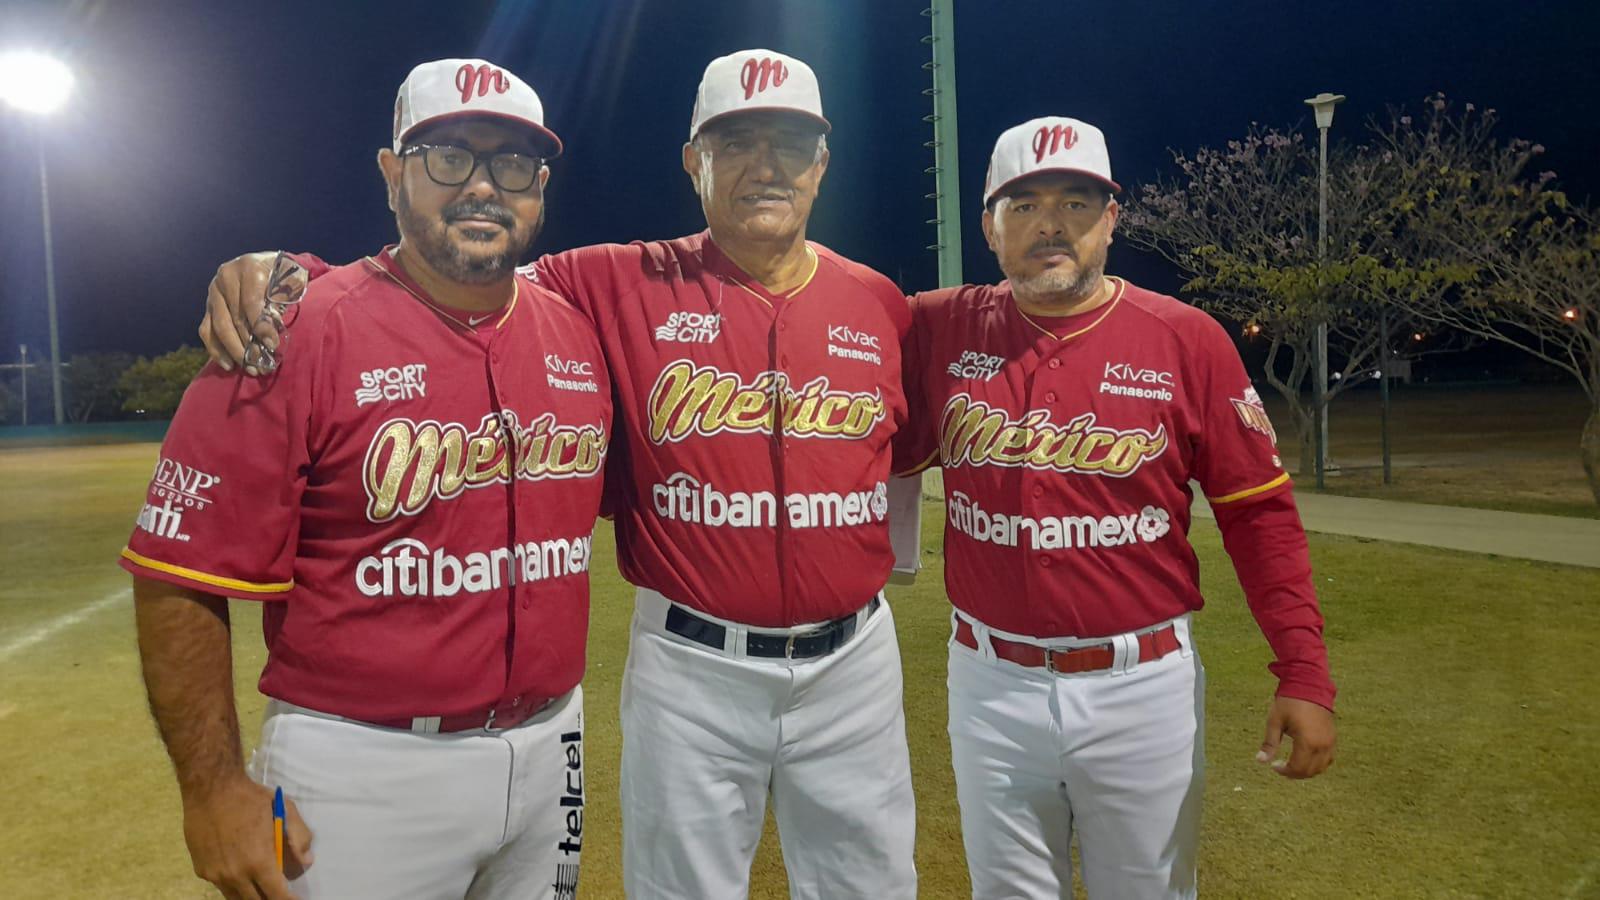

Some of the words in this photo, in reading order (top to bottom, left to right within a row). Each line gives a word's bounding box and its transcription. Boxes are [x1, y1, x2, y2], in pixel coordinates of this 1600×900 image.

[665, 312, 721, 329] SPORT
[676, 327, 721, 343] CITY
[828, 344, 881, 365] Panasonic
[960, 350, 1005, 369] SPORT
[360, 364, 427, 388] SPORT
[547, 373, 598, 392] Panasonic
[962, 366, 1000, 382] CITY
[383, 382, 426, 400] CITY
[1099, 382, 1173, 401] Panasonic
[939, 392, 1168, 478] México
[949, 490, 1138, 550] citibanamex
[558, 731, 584, 856] telcel
